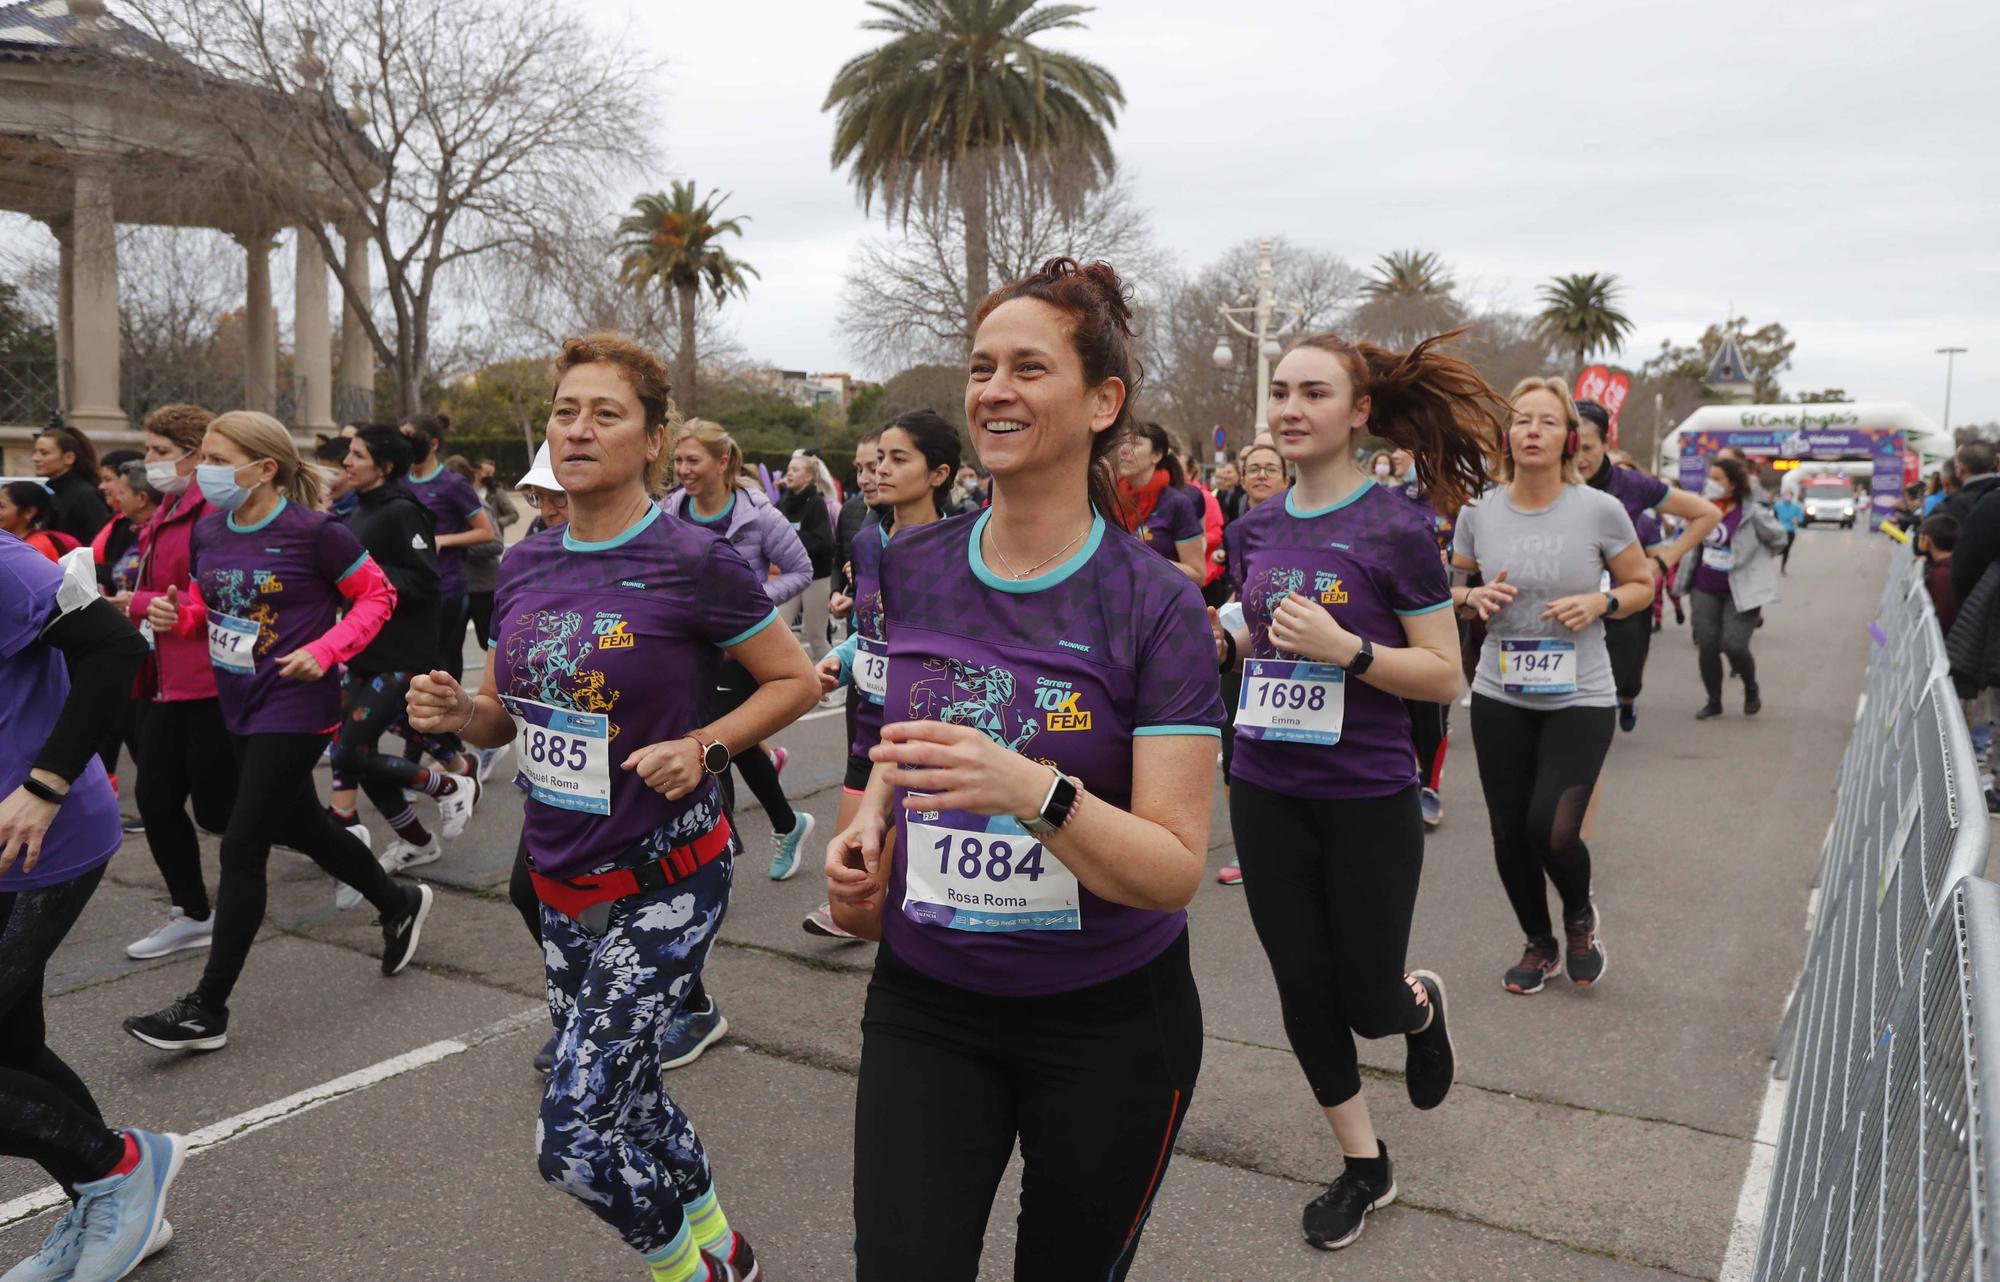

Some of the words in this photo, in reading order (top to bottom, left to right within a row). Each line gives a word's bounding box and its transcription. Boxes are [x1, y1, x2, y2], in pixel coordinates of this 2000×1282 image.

[1314, 577, 1343, 593] 10K
[1322, 593, 1347, 602] FEM
[596, 611, 623, 619] Carrera
[592, 619, 628, 636] 10K
[600, 634, 632, 648] FEM
[1513, 653, 1564, 672] 1947
[1036, 676, 1072, 689] Carrera
[1034, 687, 1081, 714] 10K
[1258, 682, 1326, 711] 1698
[1049, 713, 1089, 729] FEM
[1271, 715, 1301, 725] Emma
[523, 727, 587, 771] 1885
[550, 775, 579, 790] Roma
[934, 834, 1045, 882] 1884
[948, 888, 979, 905] Rosa
[984, 893, 1027, 907] Roma
